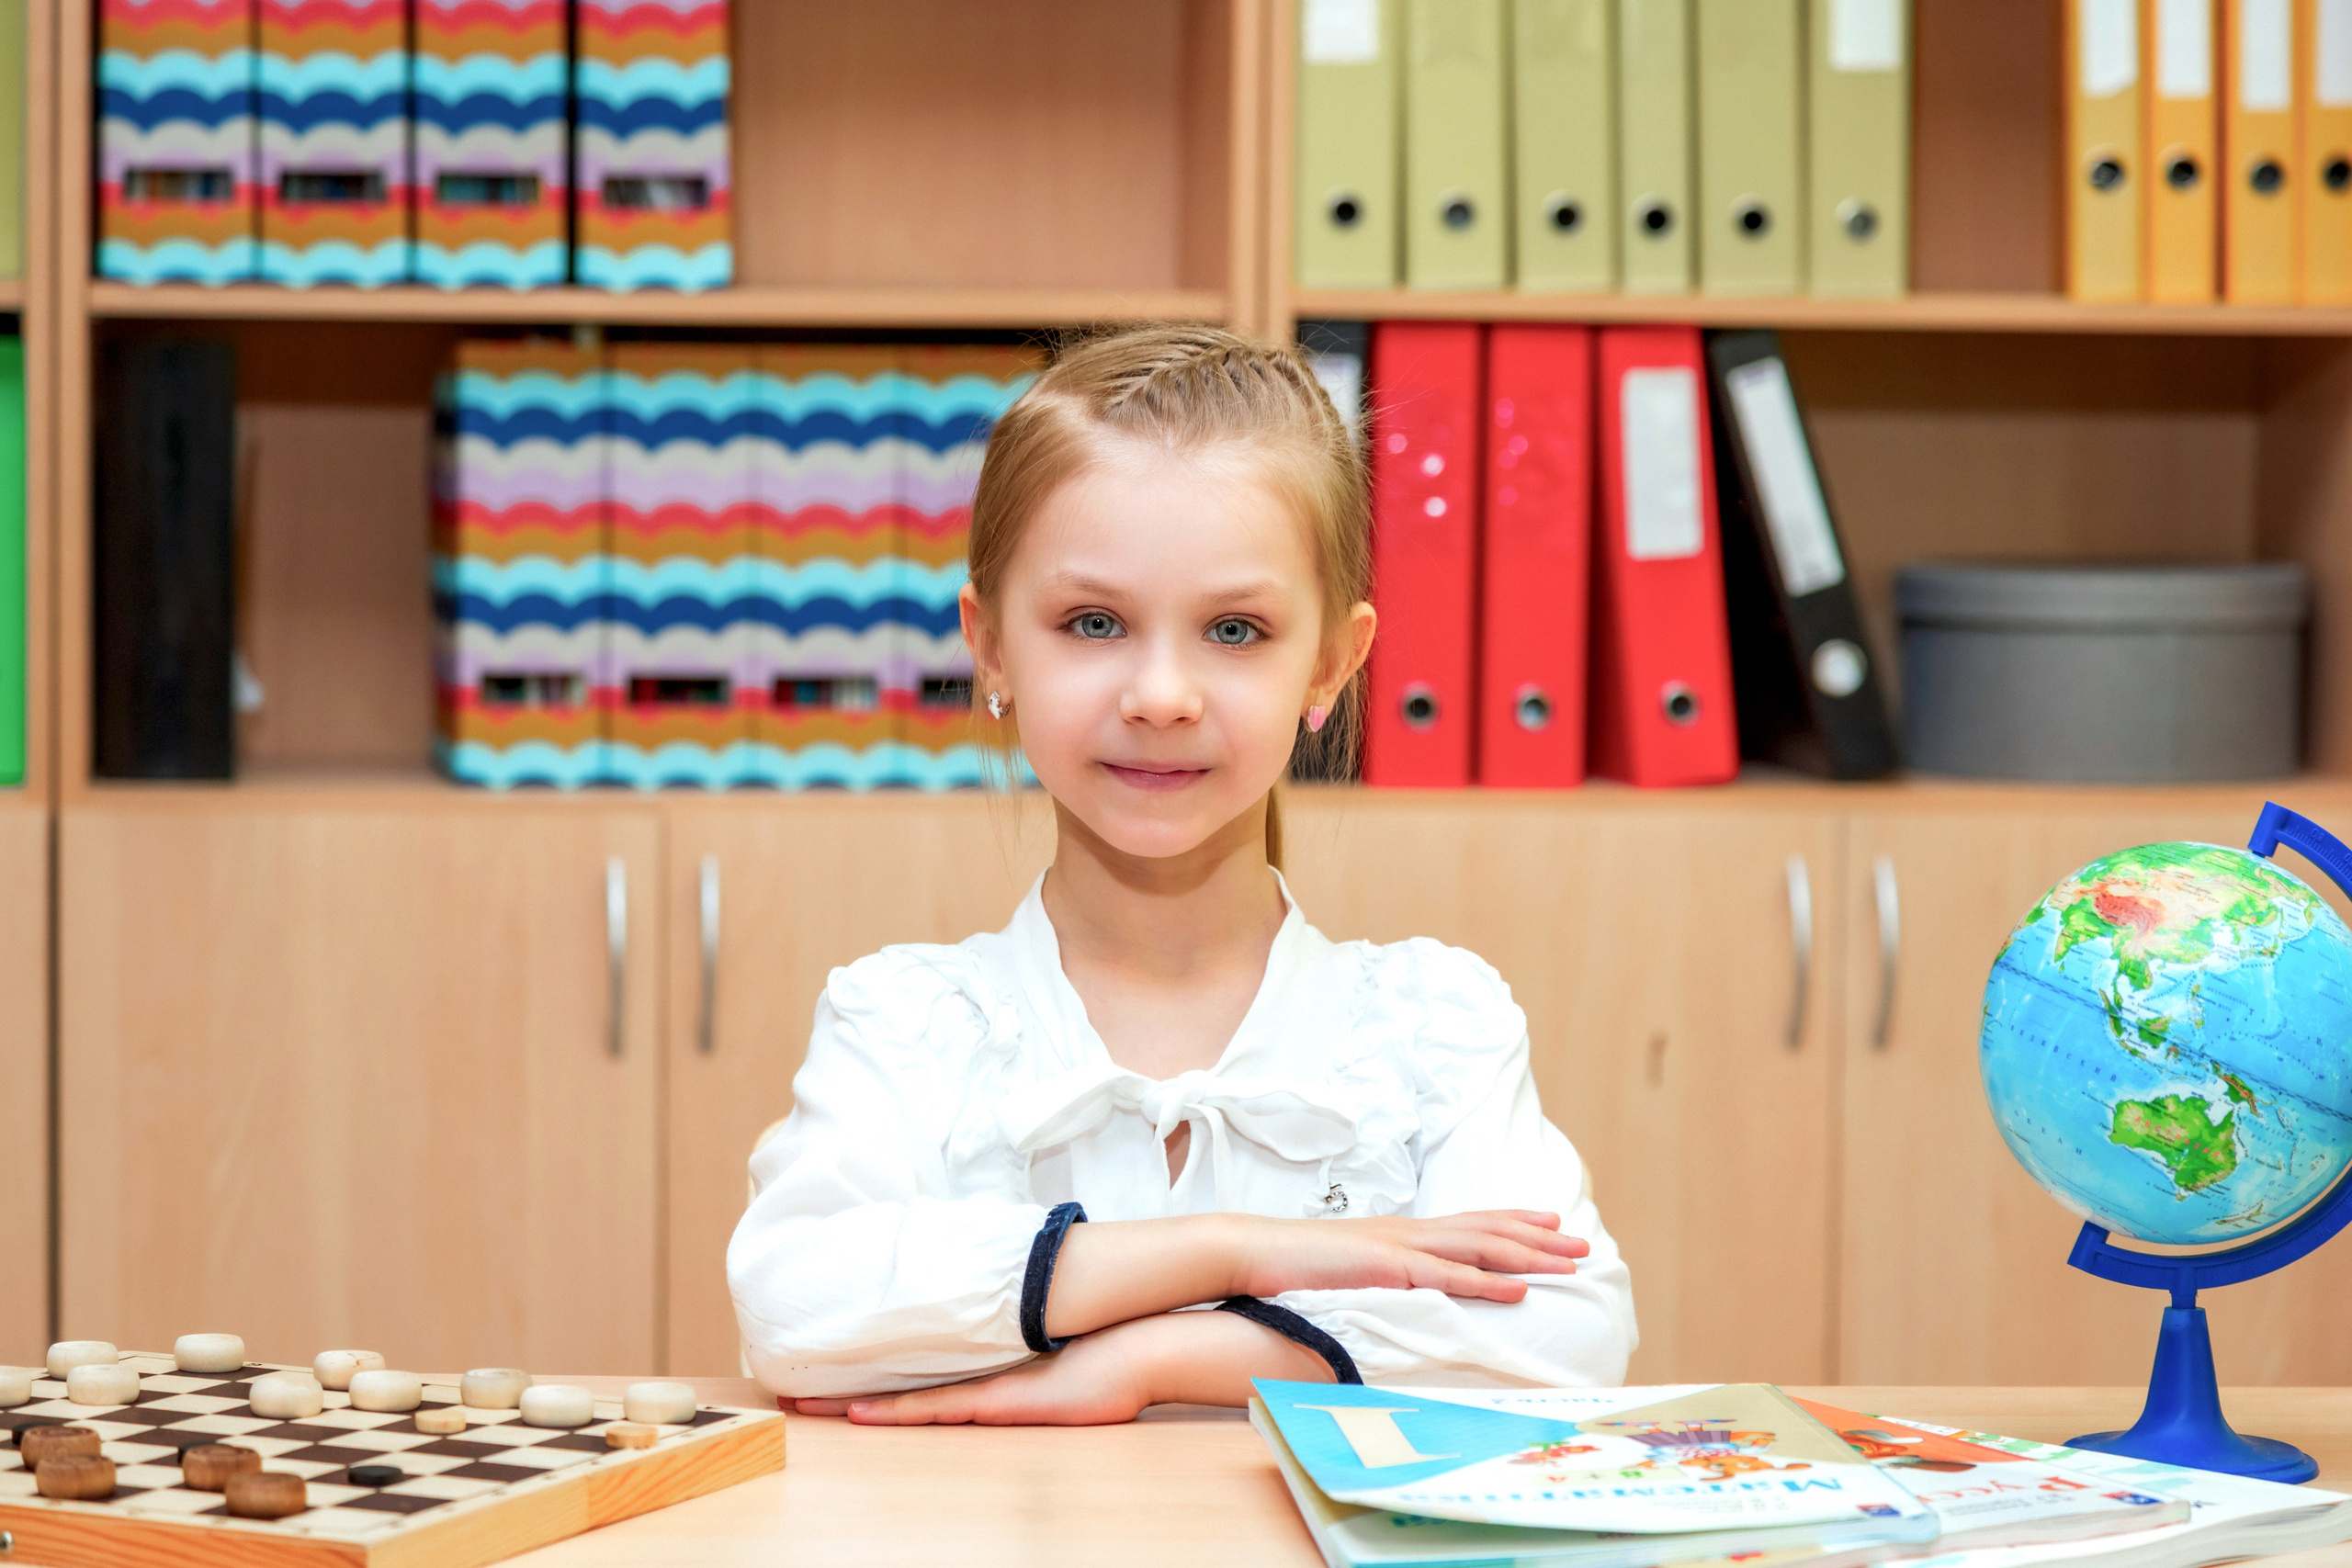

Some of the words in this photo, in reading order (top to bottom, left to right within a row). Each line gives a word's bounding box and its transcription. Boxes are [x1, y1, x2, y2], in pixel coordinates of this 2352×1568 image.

[2014, 1110, 2082, 1156] ОКЕАН
[2134, 1116, 2220, 1158] АВСТРАЛИЯ
[1399, 1478, 1843, 1503] Математика
